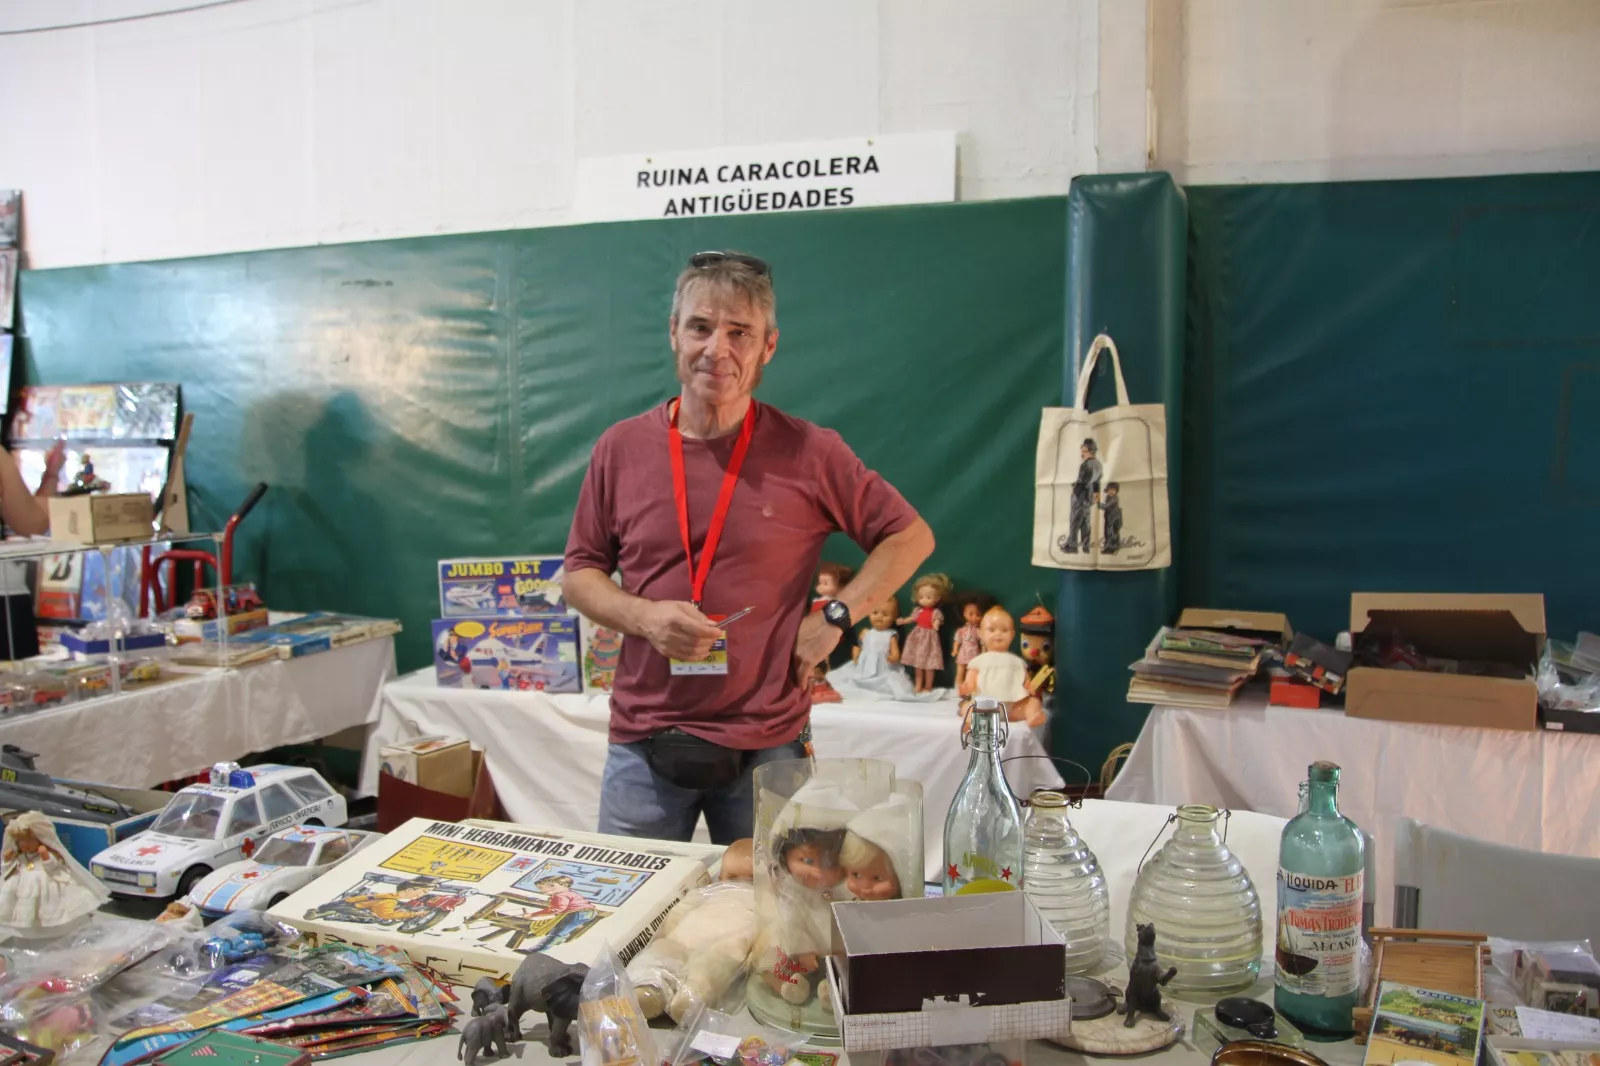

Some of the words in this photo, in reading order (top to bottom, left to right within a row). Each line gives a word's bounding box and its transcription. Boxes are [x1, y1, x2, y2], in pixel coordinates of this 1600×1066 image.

[636, 164, 710, 189] RUINA
[716, 154, 880, 183] CARACOLERA
[663, 186, 855, 217] ANTIGÜEDADES
[447, 562, 504, 577] JUMBO
[511, 560, 542, 575] JET
[269, 815, 292, 831] SERVICIO
[294, 805, 321, 820] URGENCIAS
[424, 822, 574, 856] MINI-HERRAMIENTAS
[573, 846, 672, 871] UTILIZABLES
[1312, 936, 1359, 952] ALCAÑIZ
[1416, 988, 1478, 1007] PANORAMA
